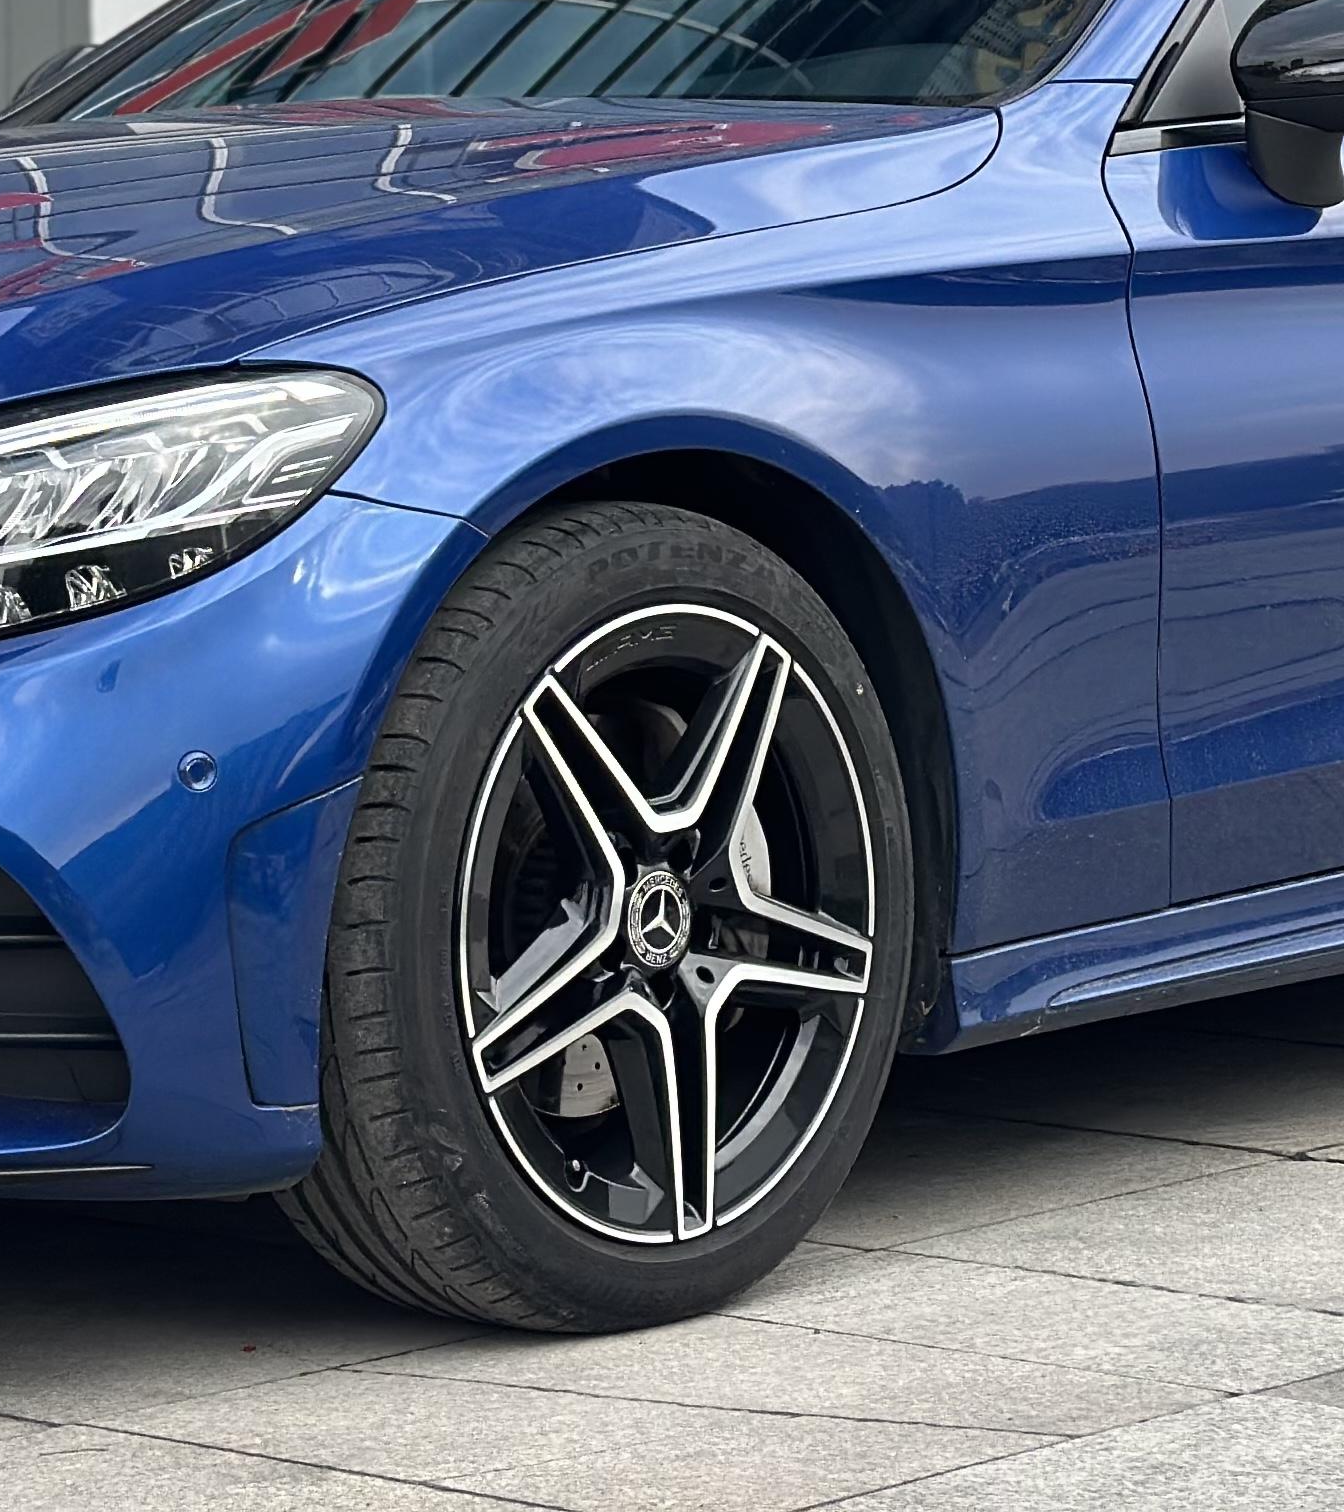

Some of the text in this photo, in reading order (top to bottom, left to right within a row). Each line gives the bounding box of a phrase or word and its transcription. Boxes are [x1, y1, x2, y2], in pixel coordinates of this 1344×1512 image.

[588, 539, 776, 585] POTENZA
[641, 873, 684, 899] MERCEDES
[644, 952, 669, 965] BENZ
